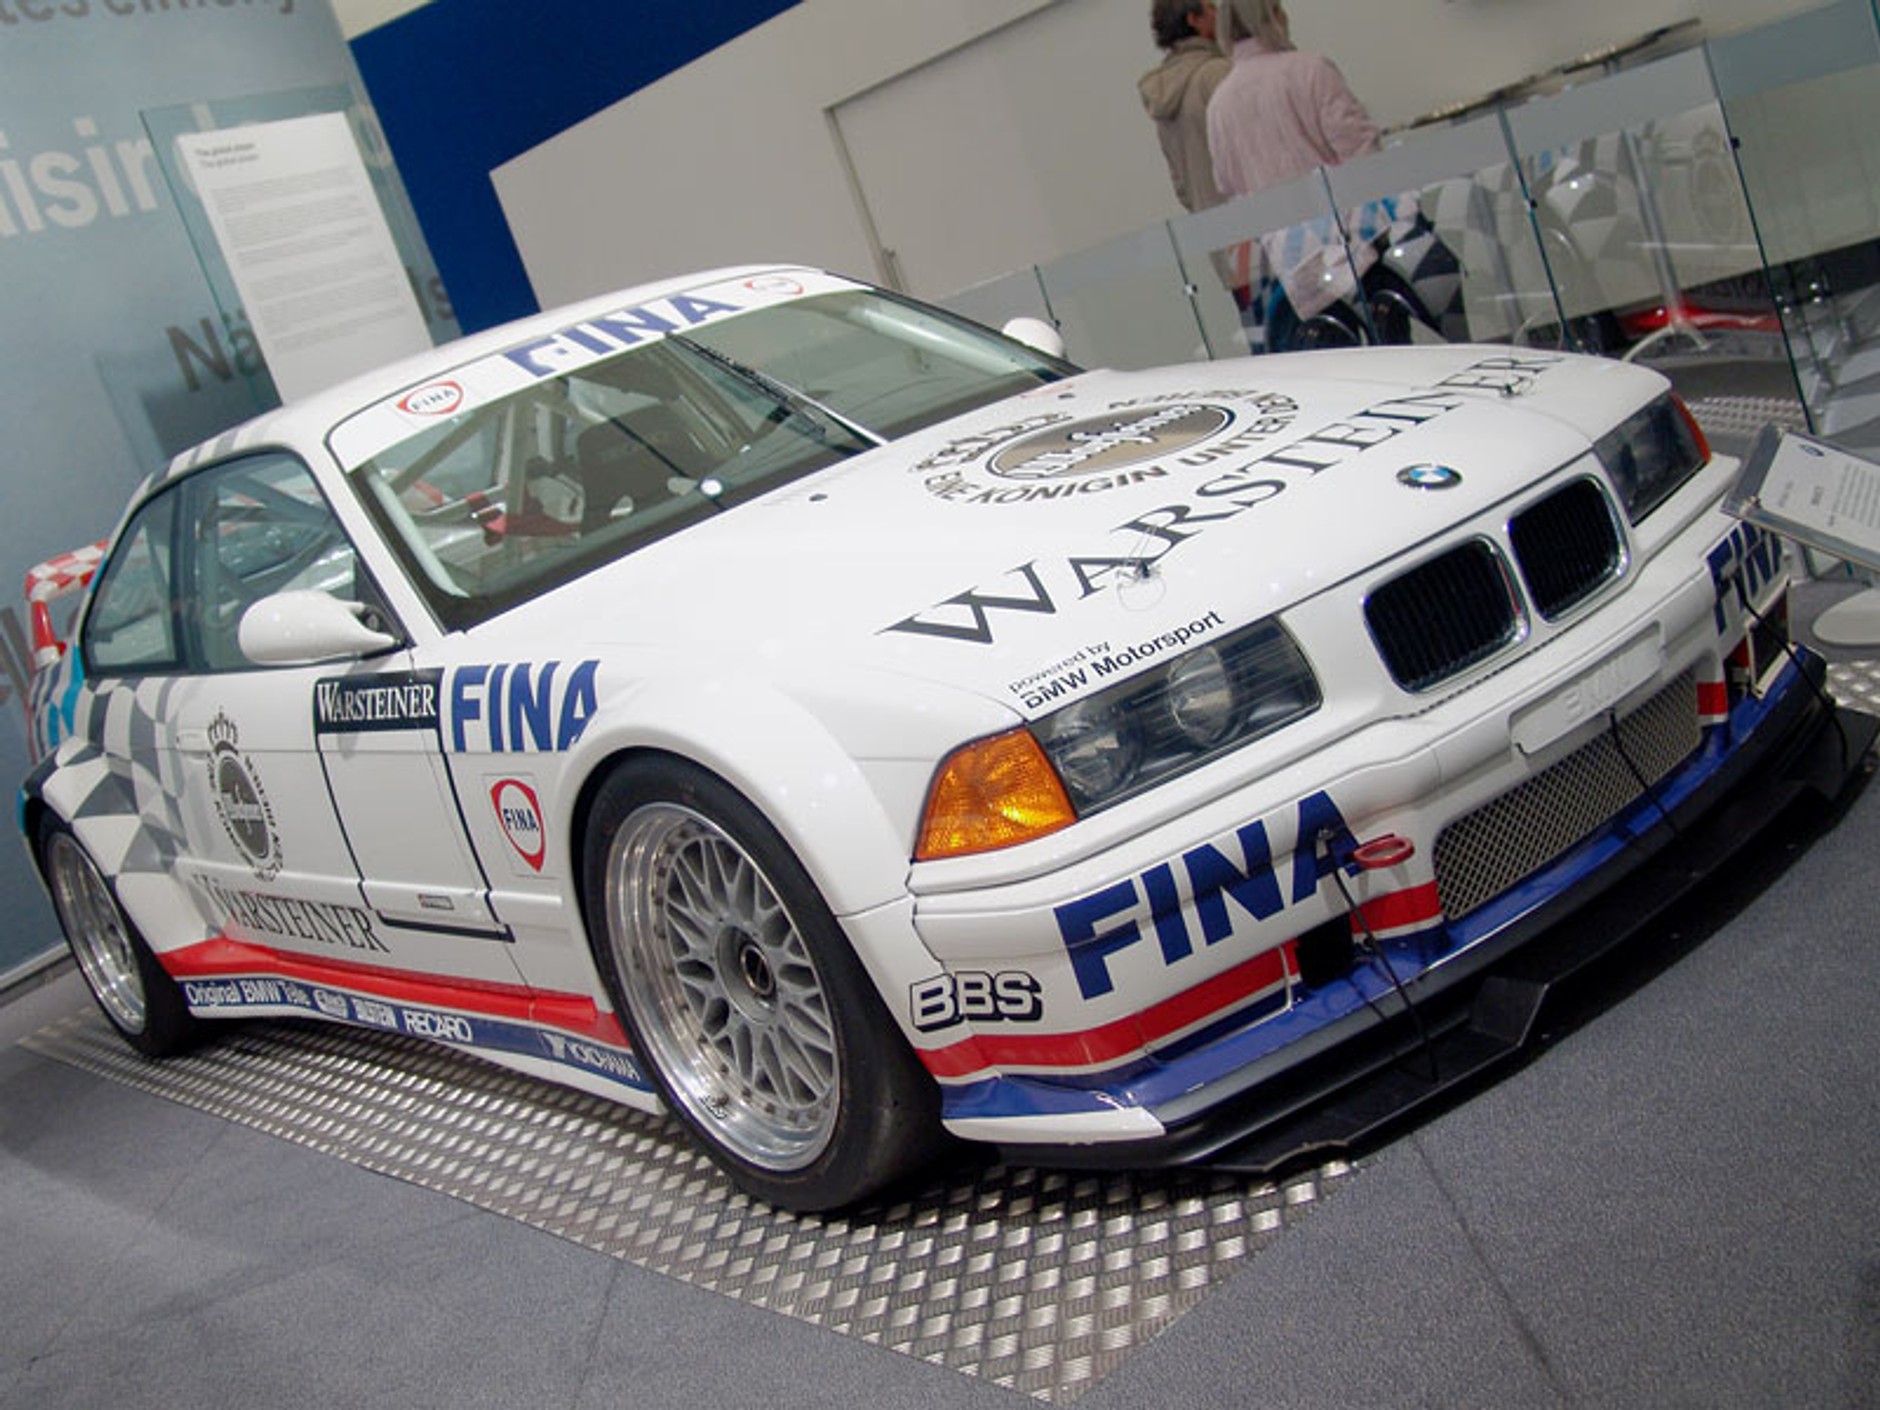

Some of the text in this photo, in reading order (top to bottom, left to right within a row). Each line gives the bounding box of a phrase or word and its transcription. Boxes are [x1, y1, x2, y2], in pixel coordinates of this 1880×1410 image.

[503, 295, 743, 378] FINA
[411, 388, 457, 411] FINA
[874, 352, 1567, 646] WARSTEINER
[1009, 641, 1112, 694] powered by
[1020, 610, 1225, 710] BMW Motorsport
[316, 679, 437, 723] WARSTEINER
[452, 660, 602, 753] FINA
[503, 808, 539, 832] FINA
[193, 873, 391, 954] WARSTEINER
[1053, 789, 1365, 1001] FINA
[185, 980, 240, 1007] Original
[240, 980, 282, 1004] BMW
[911, 971, 1042, 1034] BBS
[403, 1011, 474, 1043] RECARO
